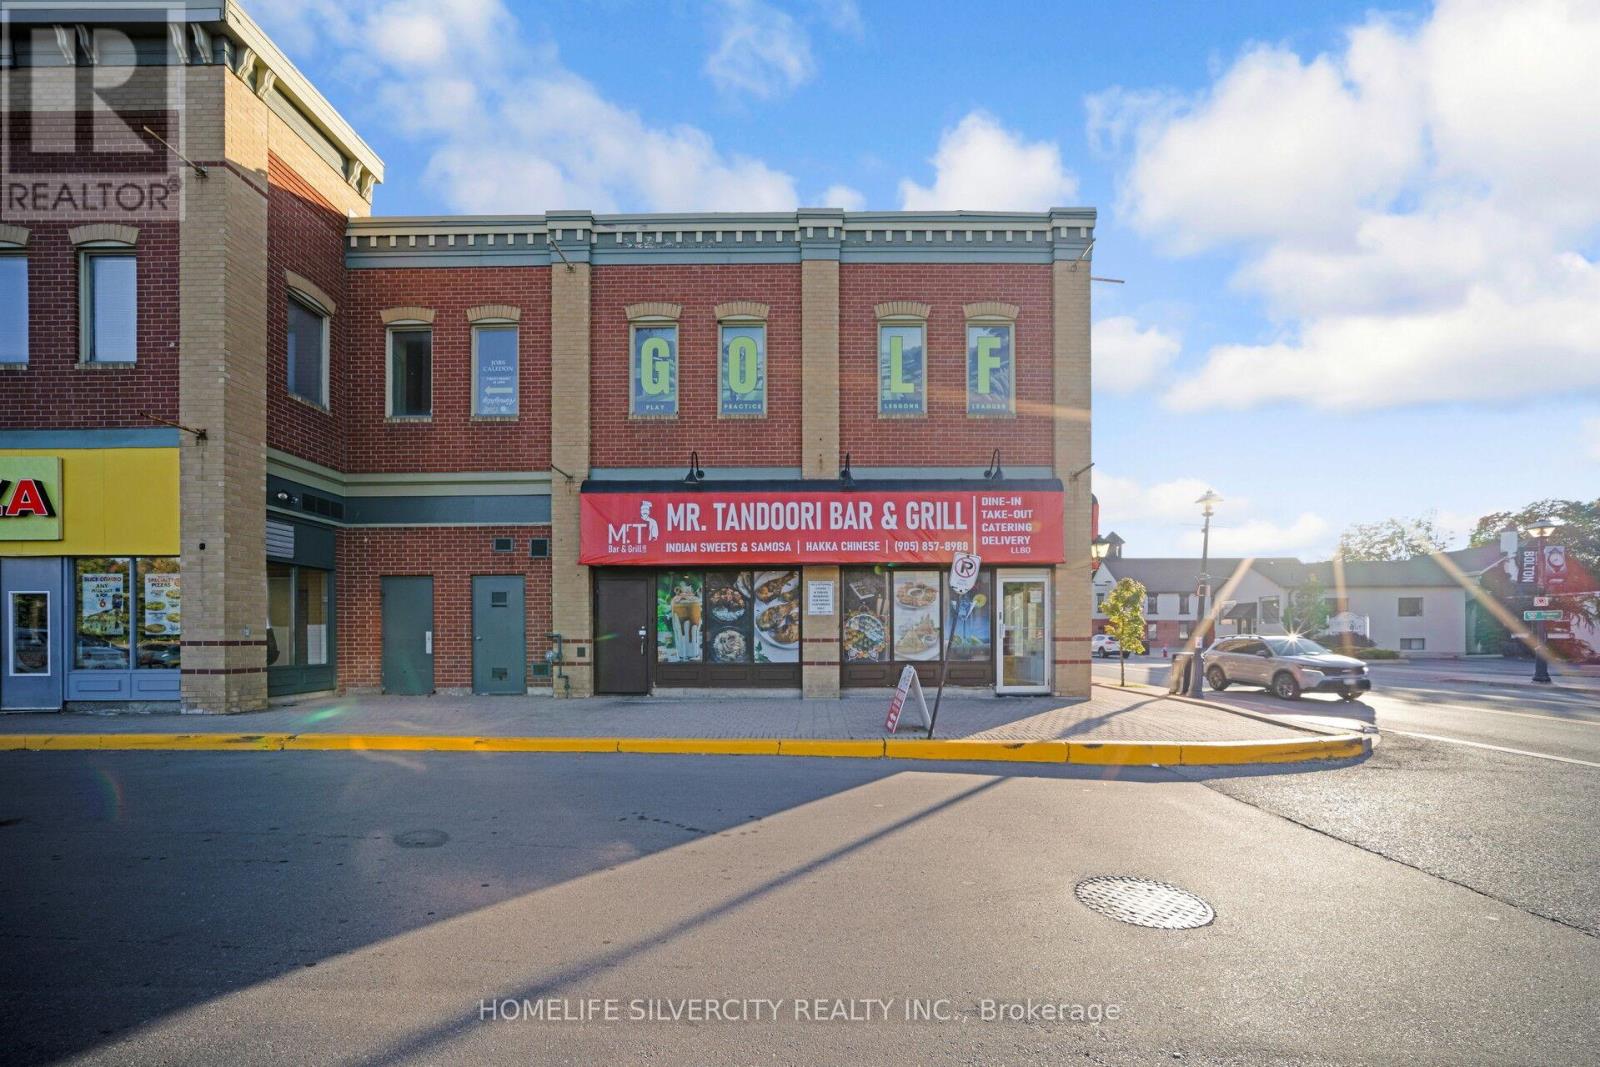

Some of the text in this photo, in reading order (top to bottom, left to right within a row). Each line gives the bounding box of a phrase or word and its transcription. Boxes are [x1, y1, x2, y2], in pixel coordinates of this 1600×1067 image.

[981, 497, 1022, 506] DINE-IN
[666, 501, 968, 531] MR. TANDOORI BAR & GRILL
[981, 510, 1033, 519] TAKE-OUT
[981, 523, 1033, 532] CATERING
[981, 536, 1031, 545] DELIVERY
[608, 544, 620, 553] Bar
[620, 544, 626, 553] &
[628, 544, 642, 553] Grill
[665, 541, 791, 553] INDIAN SWEETS & SAMOSA
[806, 541, 881, 552] HAKKA CHINESE
[894, 540, 969, 553] (905) 857-8988
[1522, 551, 1536, 583] BOLTON
